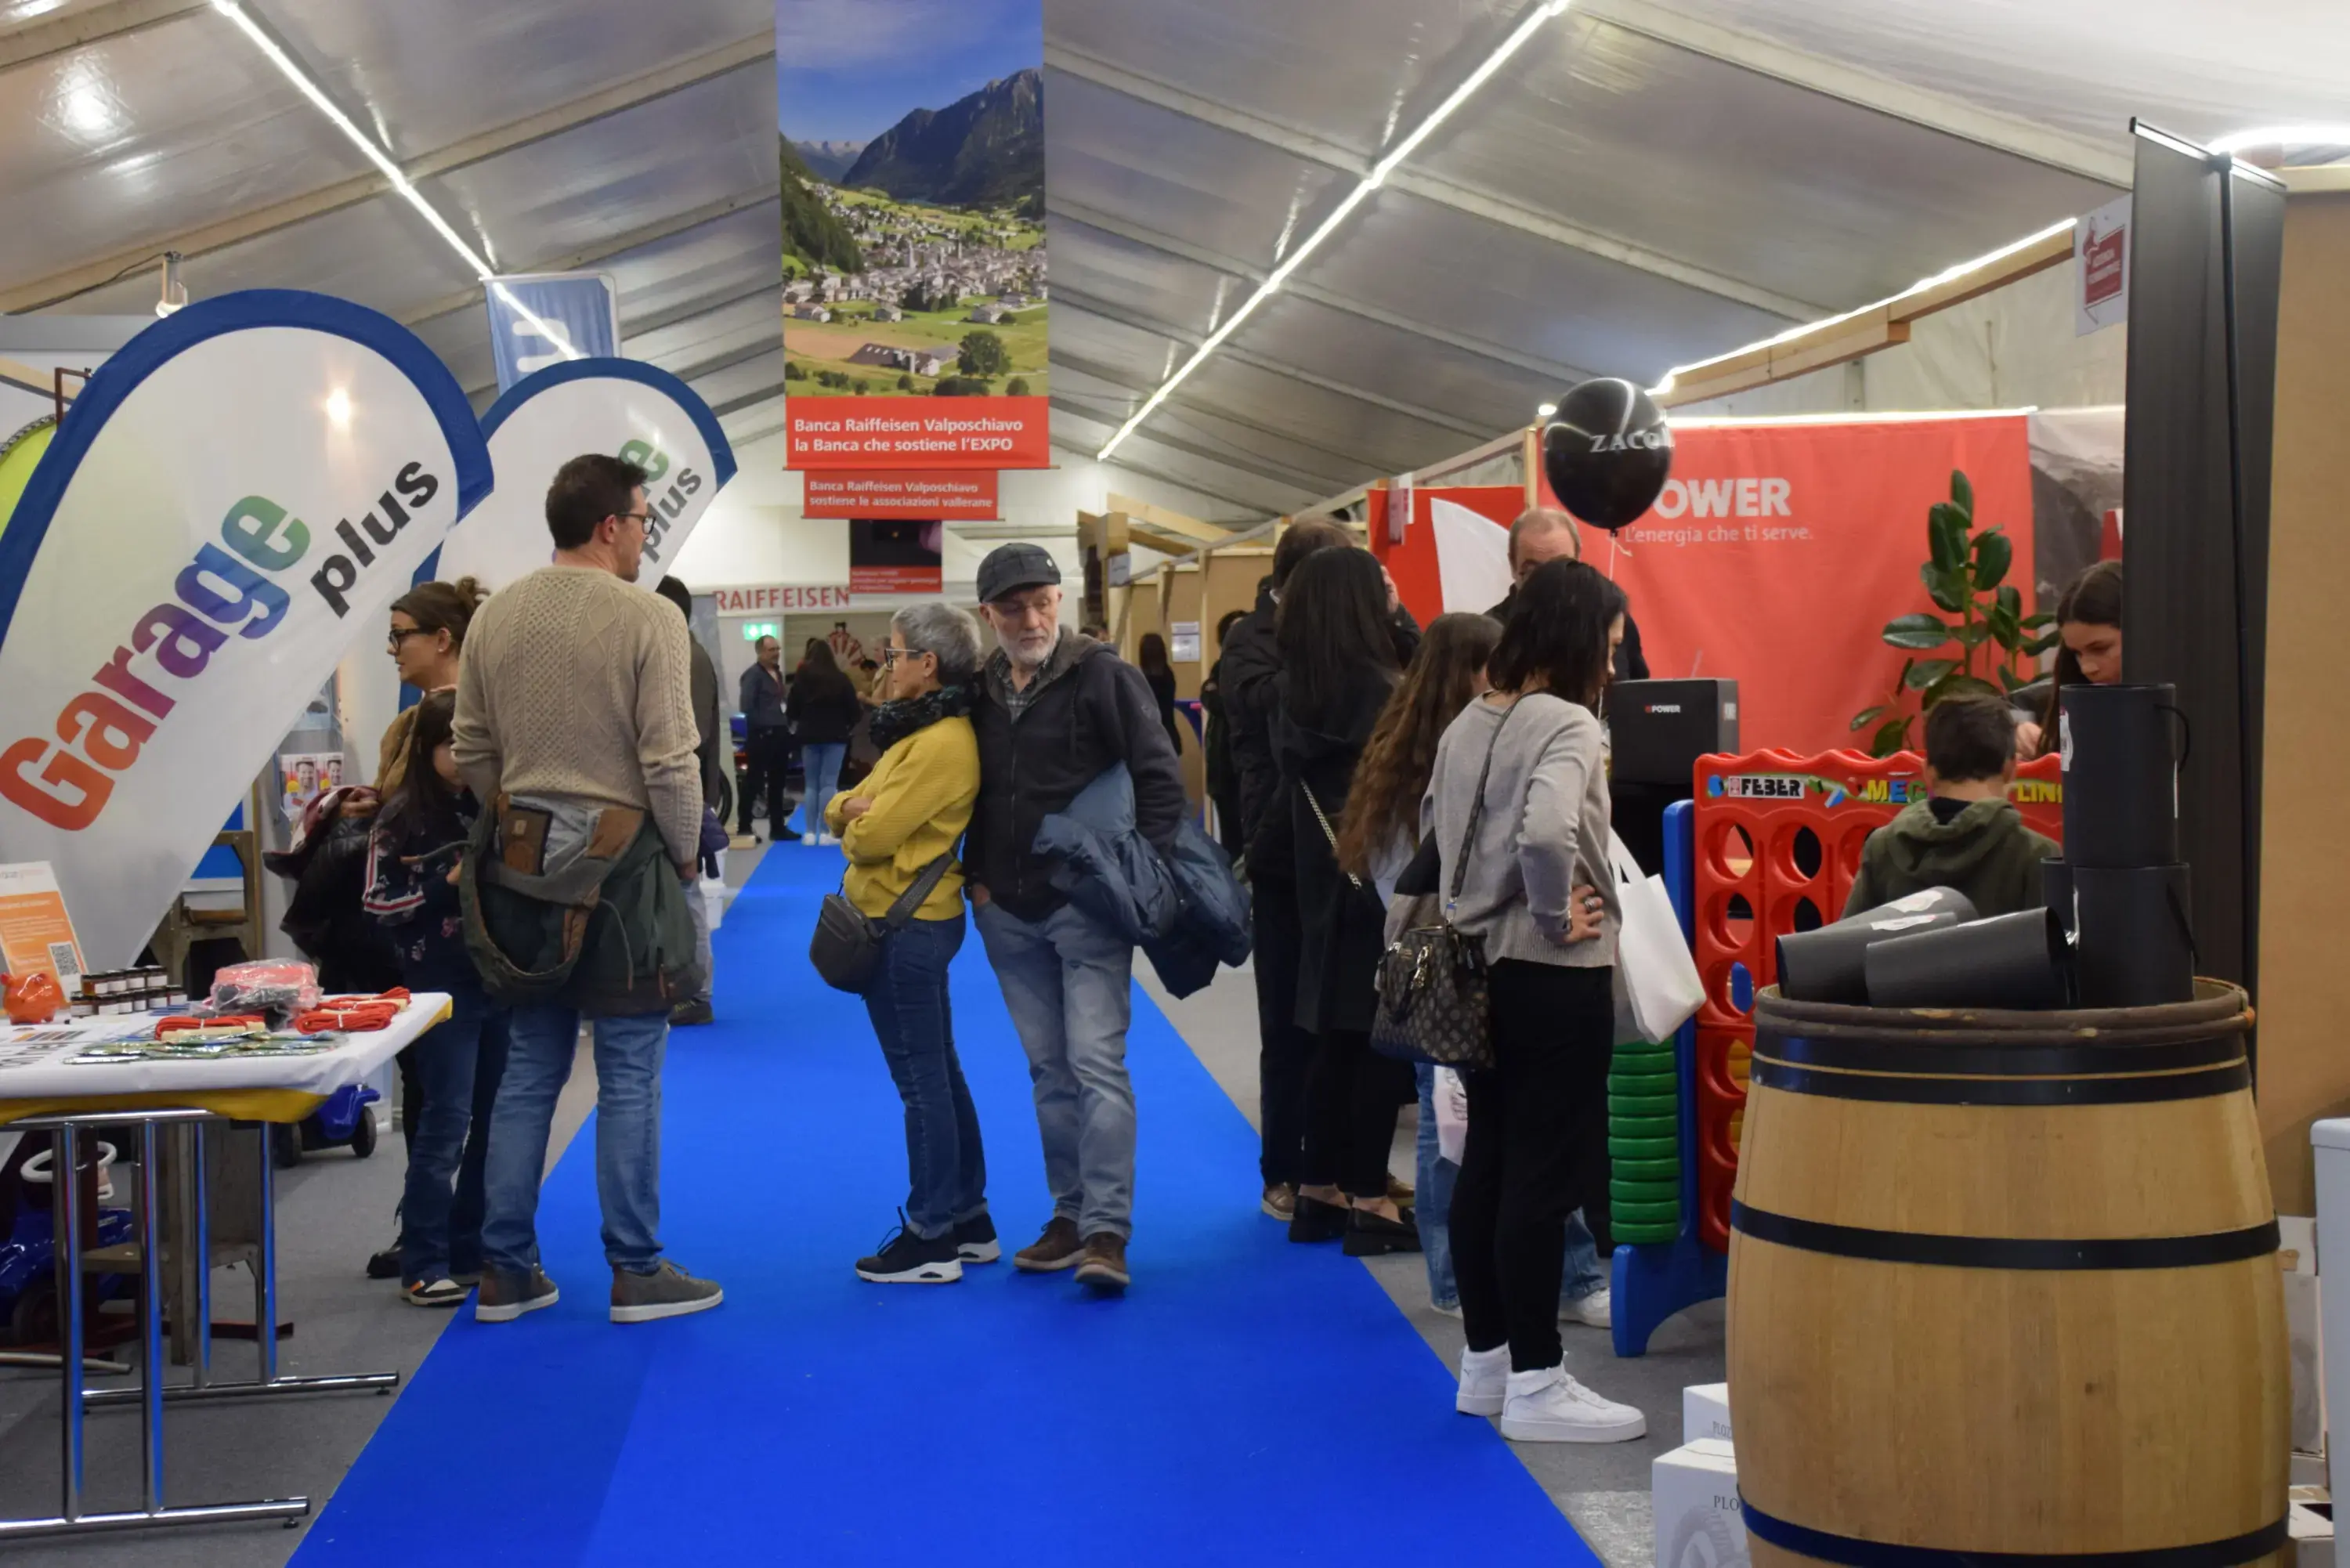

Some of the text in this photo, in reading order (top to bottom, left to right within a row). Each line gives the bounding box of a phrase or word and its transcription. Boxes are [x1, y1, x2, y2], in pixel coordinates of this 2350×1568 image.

[794, 417, 1023, 435] Banca Raiffeisen Valposchiavo
[795, 438, 1013, 451] la Banca che sostiene l'EXPO
[810, 481, 978, 495] Banca Raiffeisen Valposchiavo
[809, 496, 992, 508] sostiene le associazioni vallerane
[1653, 477, 1792, 519] OWER
[1625, 524, 1814, 547] L'energia che ti serve.
[712, 587, 850, 610] RAIFFEISEN
[0, 461, 439, 830] Garage plus
[1741, 778, 1801, 797] FEBER
[1867, 779, 1932, 804] MEG
[1712, 1421, 1732, 1440] PLOZ
[1713, 1494, 1740, 1512] PLO
